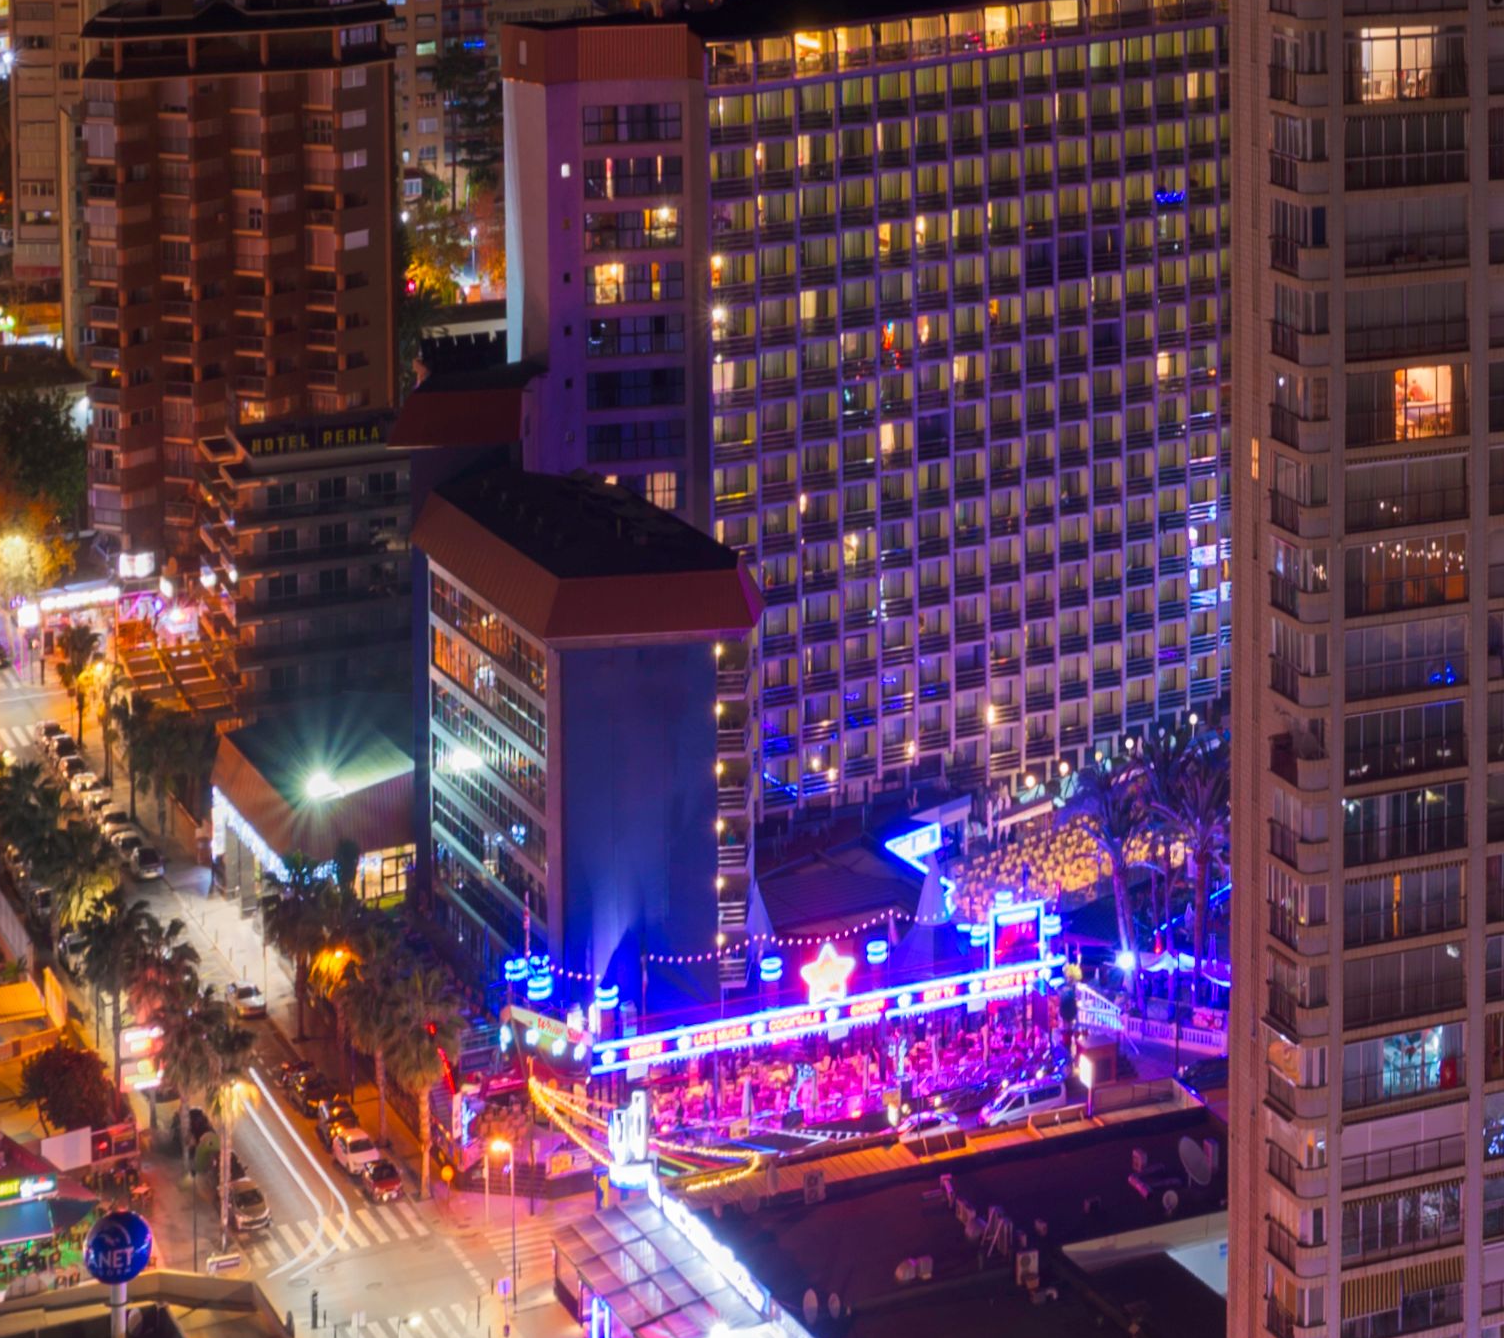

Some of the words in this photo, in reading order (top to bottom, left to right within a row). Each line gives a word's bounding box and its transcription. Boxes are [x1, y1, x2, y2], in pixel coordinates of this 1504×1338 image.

[251, 434, 310, 454] HOTEL
[322, 425, 380, 446] PERLA
[768, 1011, 822, 1032] COCKTAILS
[693, 1031, 716, 1047] LIVE
[717, 1024, 748, 1042] MUSIC
